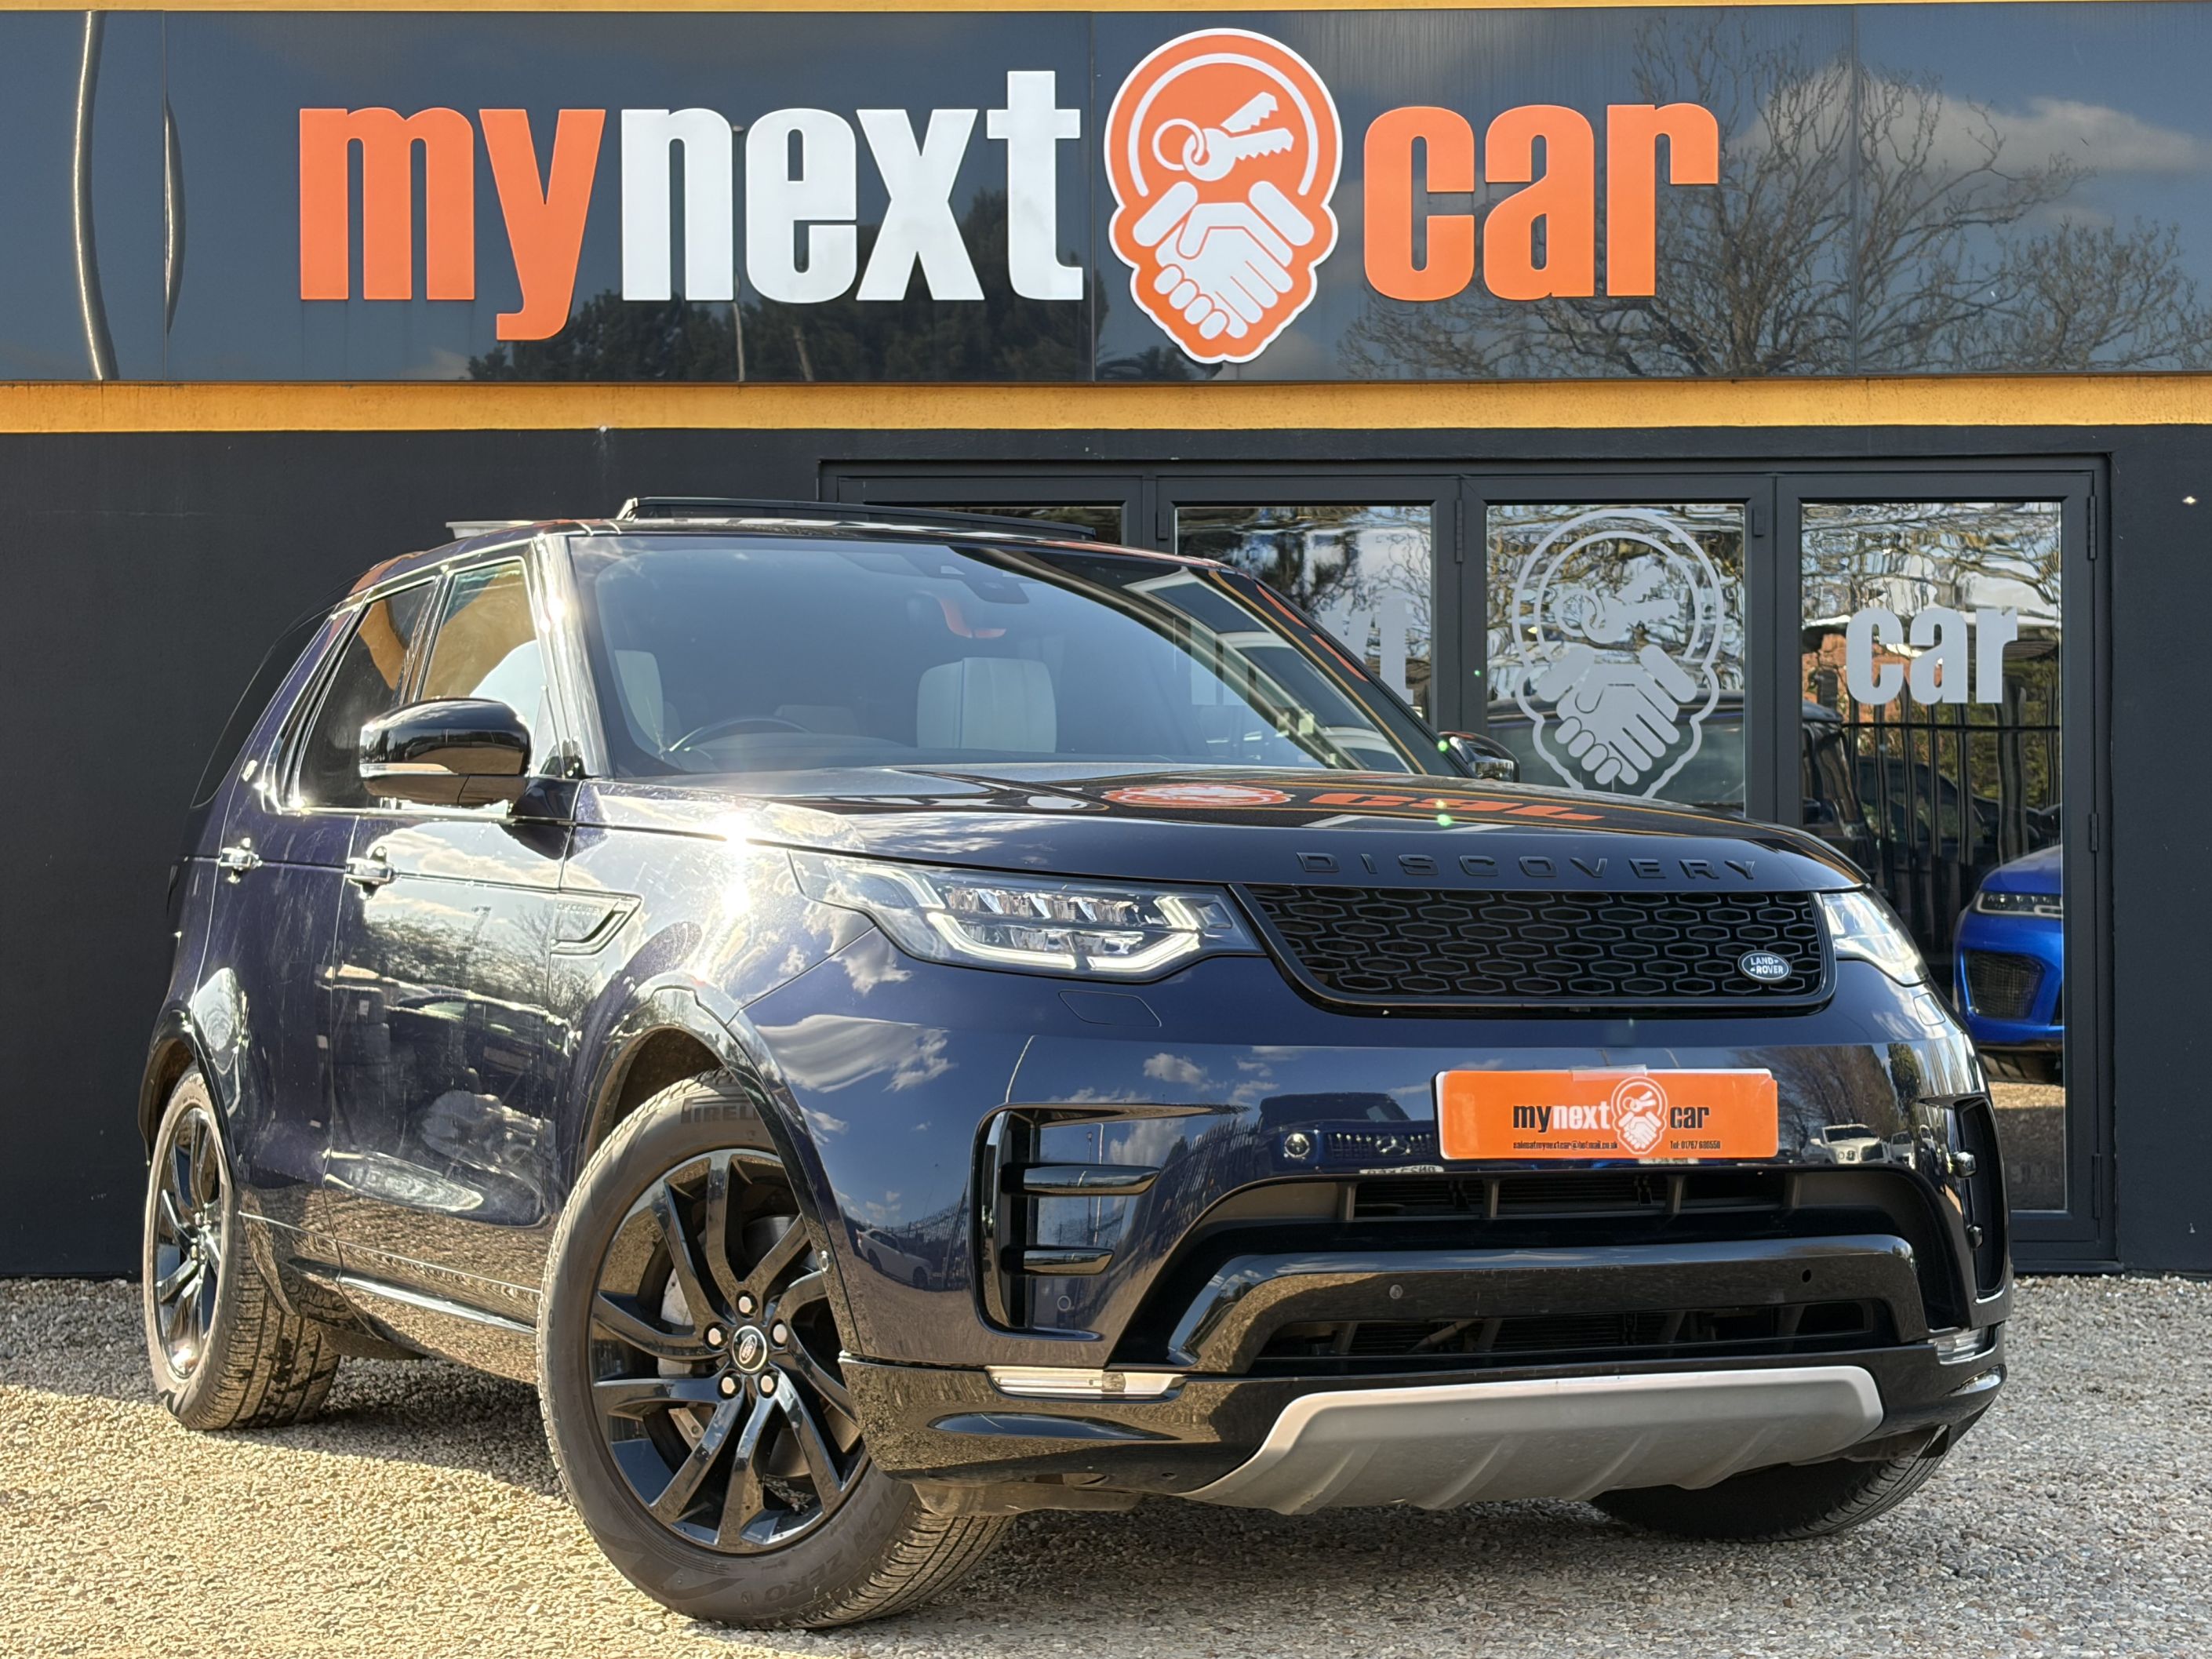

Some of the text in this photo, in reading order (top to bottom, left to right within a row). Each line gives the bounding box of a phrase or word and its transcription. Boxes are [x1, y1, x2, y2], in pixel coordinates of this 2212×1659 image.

[1363, 103, 1719, 301] car
[1846, 607, 2018, 705] car
[1297, 851, 1756, 880] DISCOVERY
[1750, 956, 1774, 966] LAND
[1756, 965, 1784, 974] ROVER
[1670, 1107, 1710, 1129] car
